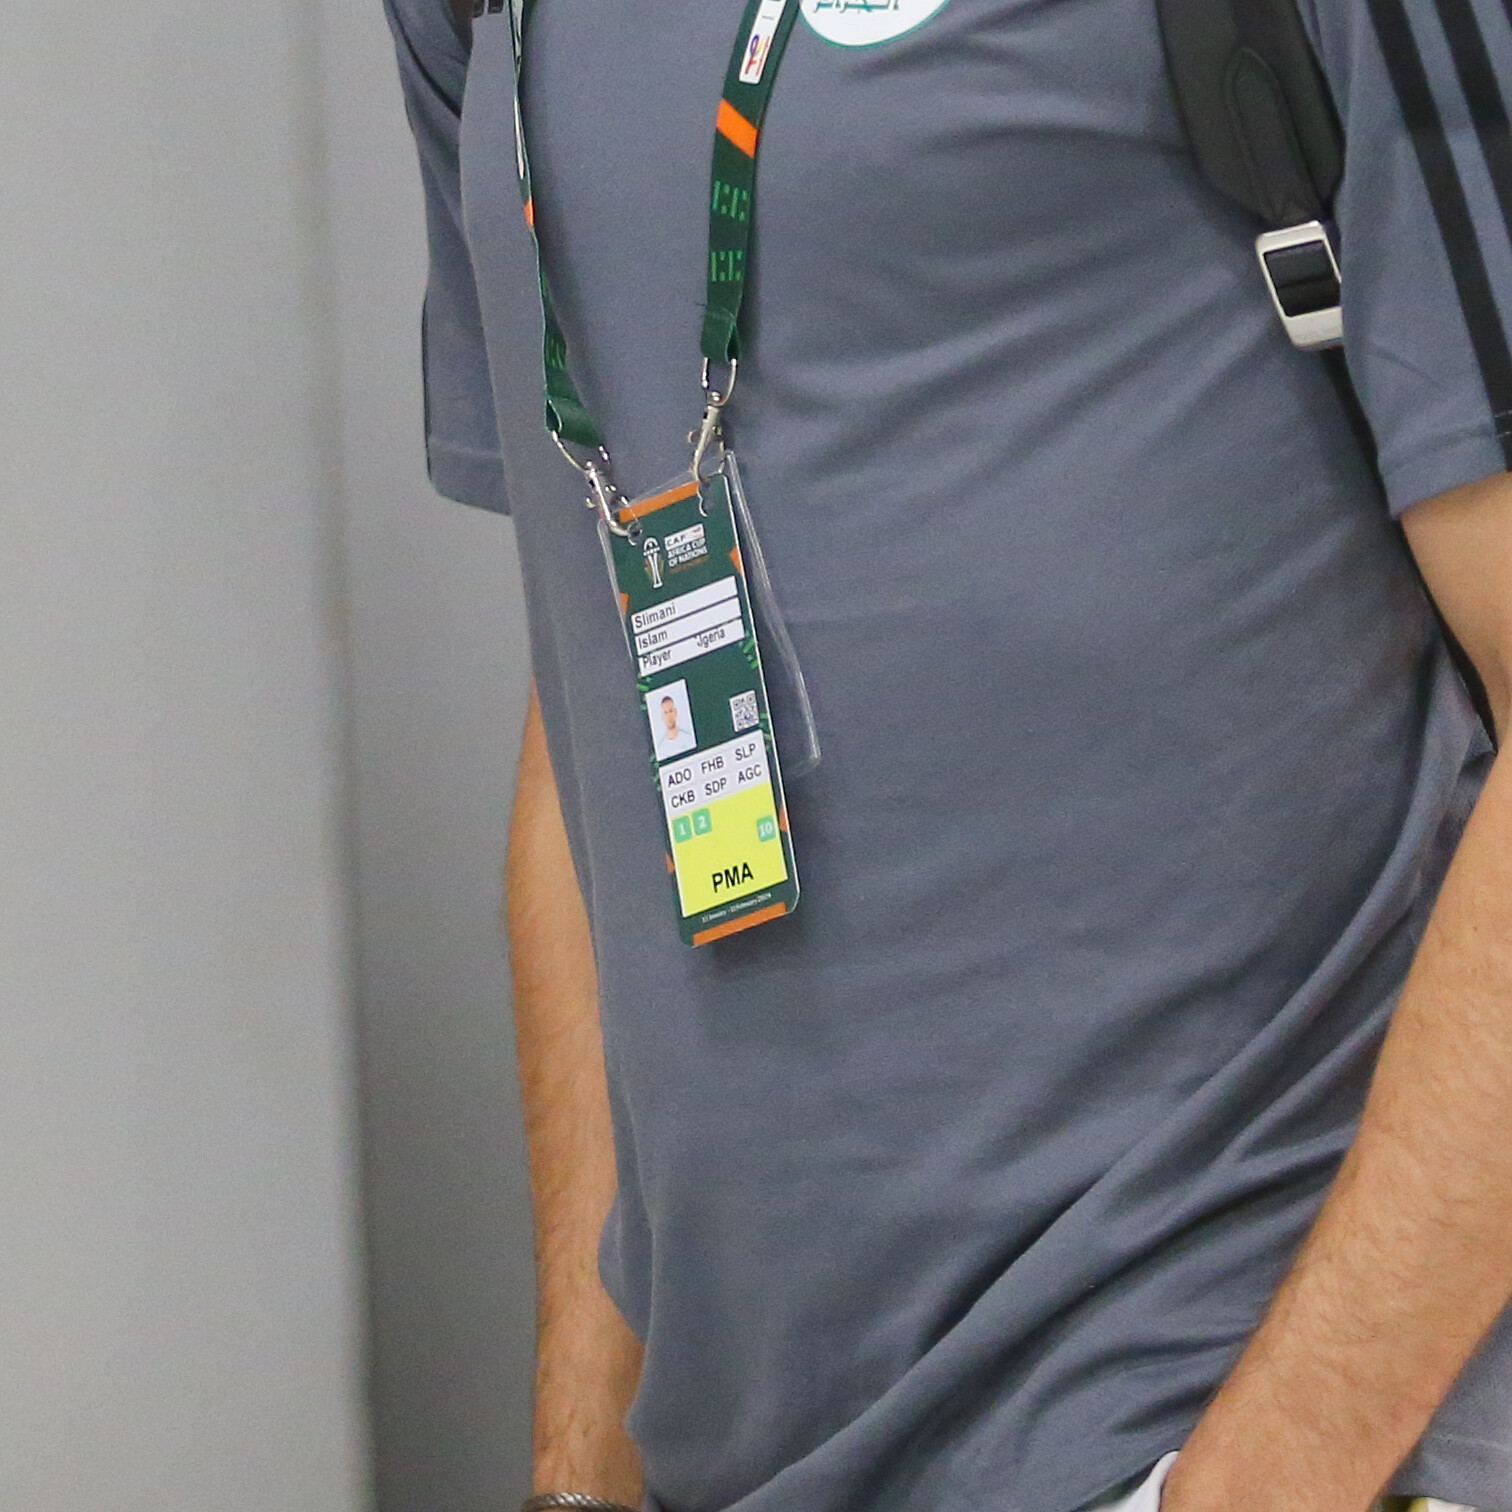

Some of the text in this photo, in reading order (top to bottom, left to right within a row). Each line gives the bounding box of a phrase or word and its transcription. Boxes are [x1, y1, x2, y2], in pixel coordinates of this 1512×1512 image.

[635, 602, 676, 628] Slimani
[638, 630, 668, 649] Islam
[643, 649, 672, 668] Player
[668, 743, 756, 787] ADO FHB SLP
[671, 764, 762, 808] CKB SDP AGC
[698, 816, 707, 829] 2
[759, 821, 773, 835] 10
[712, 862, 754, 893] PMA
